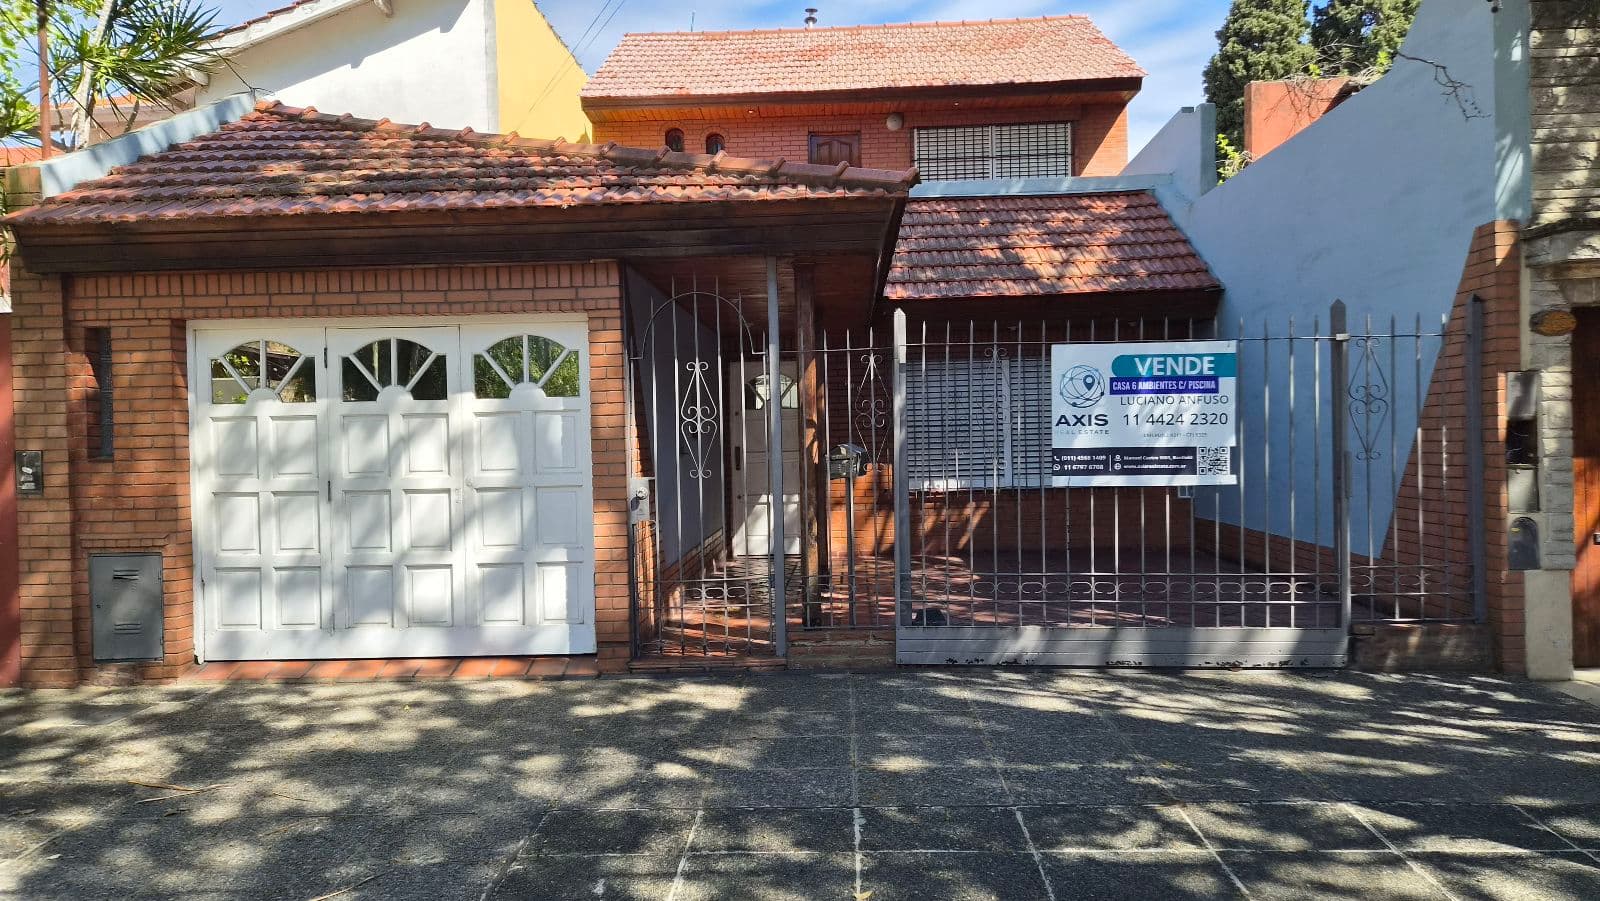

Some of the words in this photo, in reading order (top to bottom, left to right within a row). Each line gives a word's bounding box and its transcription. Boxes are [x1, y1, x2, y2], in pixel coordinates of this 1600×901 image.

[1134, 356, 1215, 376] VENDE
[1112, 381, 1130, 391] CASA
[1131, 381, 1137, 390] 6
[1138, 381, 1177, 390] AMBIENTES
[1178, 380, 1187, 390] C/
[1188, 380, 1216, 389] PISCINA
[1120, 396, 1175, 406] LUCIANO
[1178, 395, 1229, 405] ANFUSO
[1055, 414, 1109, 427] AXIS
[1123, 413, 1140, 426] 11
[1146, 413, 1184, 425] 4424
[1190, 412, 1228, 425] 2320
